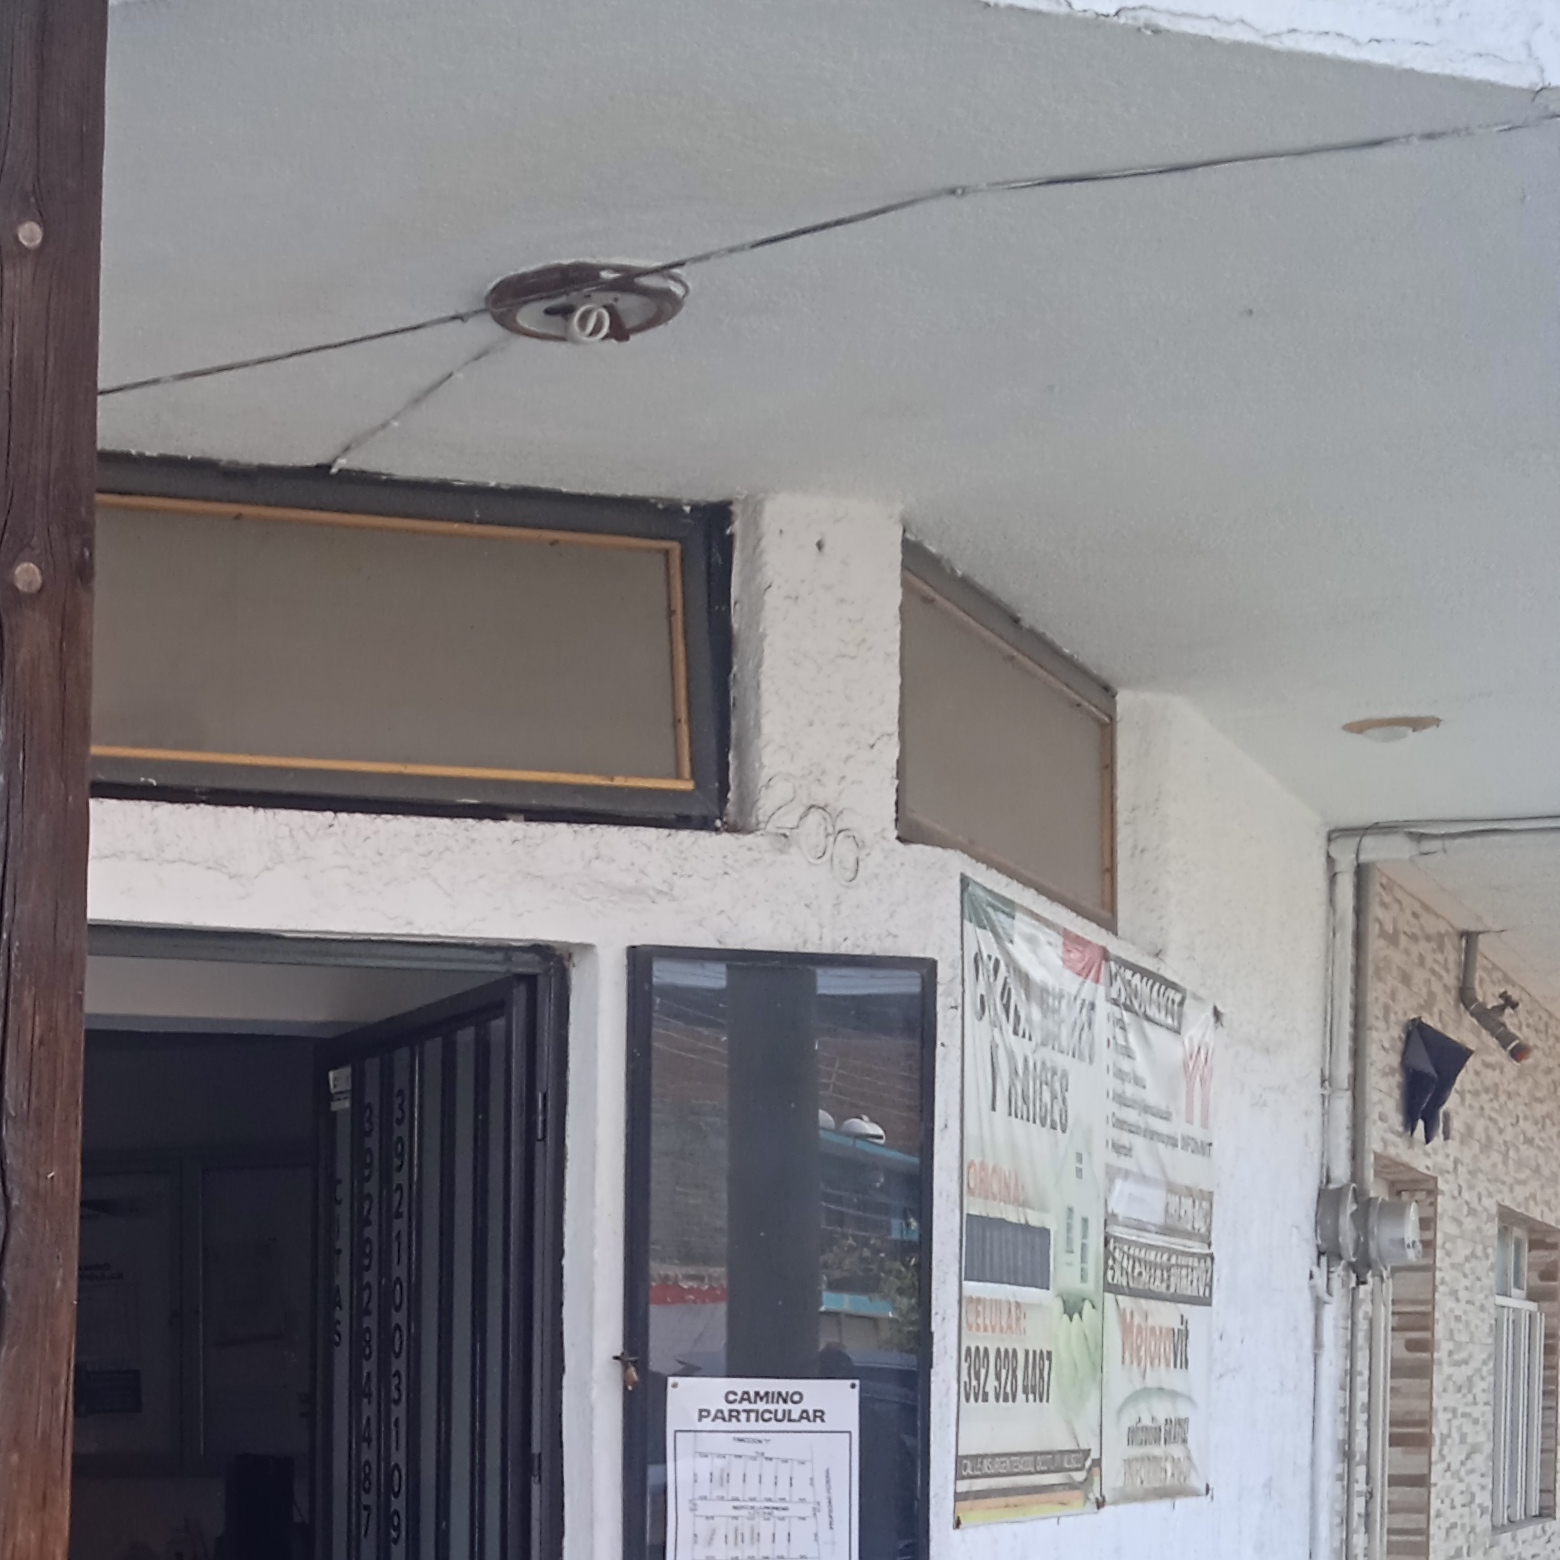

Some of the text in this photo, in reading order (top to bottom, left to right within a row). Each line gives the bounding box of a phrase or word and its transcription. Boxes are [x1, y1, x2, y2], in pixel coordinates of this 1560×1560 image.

[965, 1295, 1027, 1336] CELULAR:
[963, 1345, 1053, 1404] 392 928 4487
[724, 1390, 804, 1405] CAMINO
[697, 1408, 826, 1424] PARTICULAR
